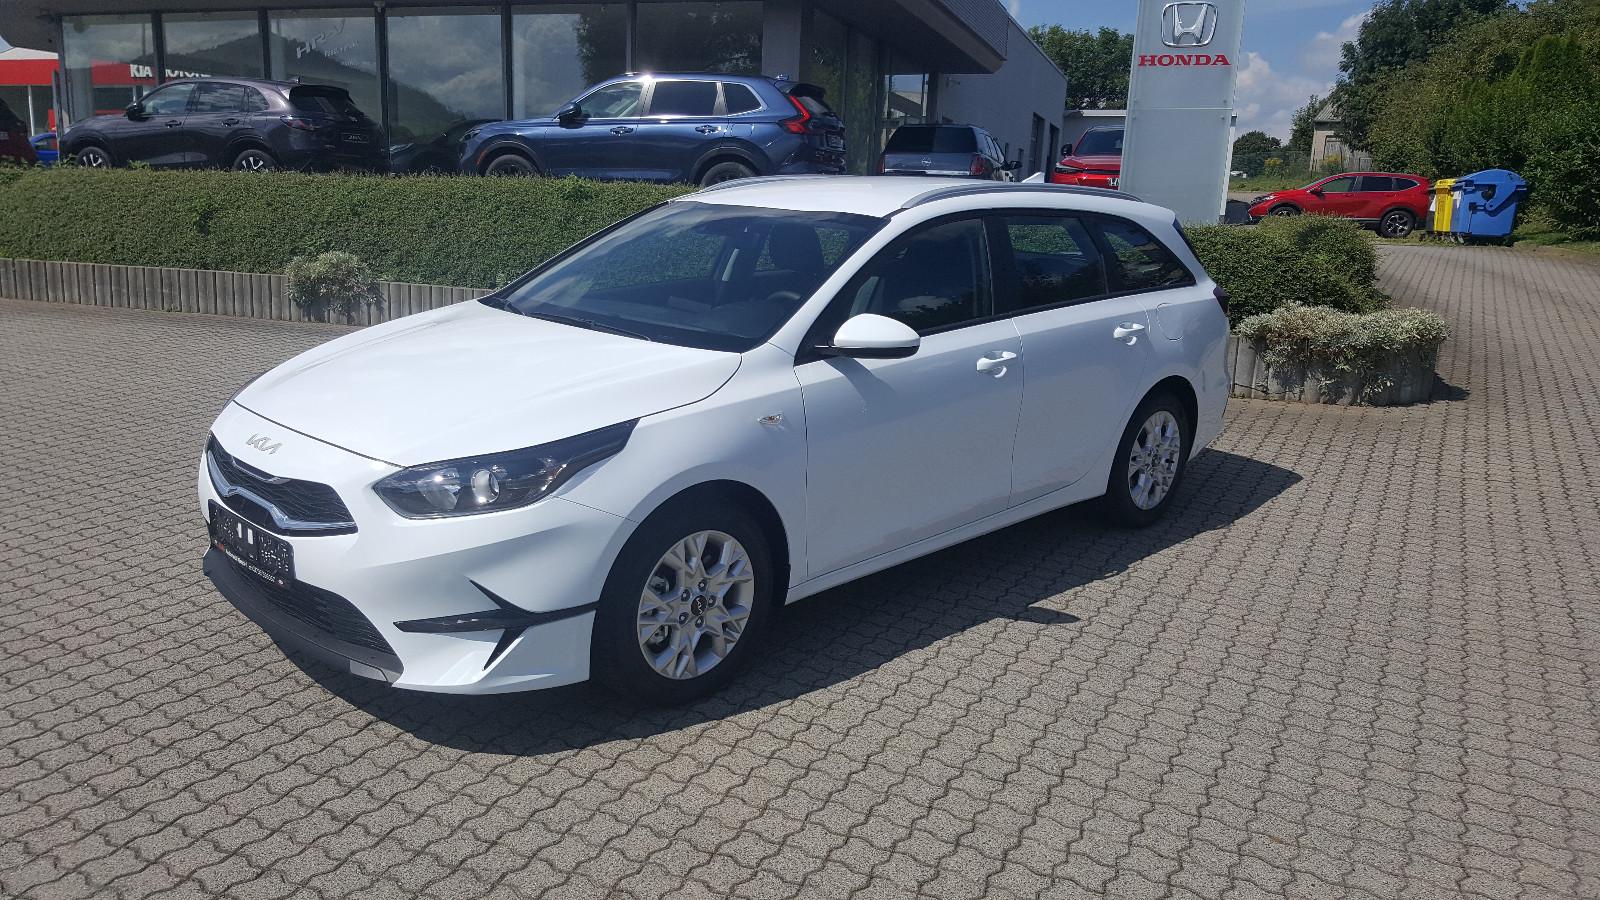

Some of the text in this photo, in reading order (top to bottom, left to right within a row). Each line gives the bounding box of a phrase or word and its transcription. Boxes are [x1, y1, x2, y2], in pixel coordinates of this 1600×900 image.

[1138, 54, 1231, 67] HONDA
[129, 64, 153, 78] KIA
[246, 433, 282, 455] KIA
